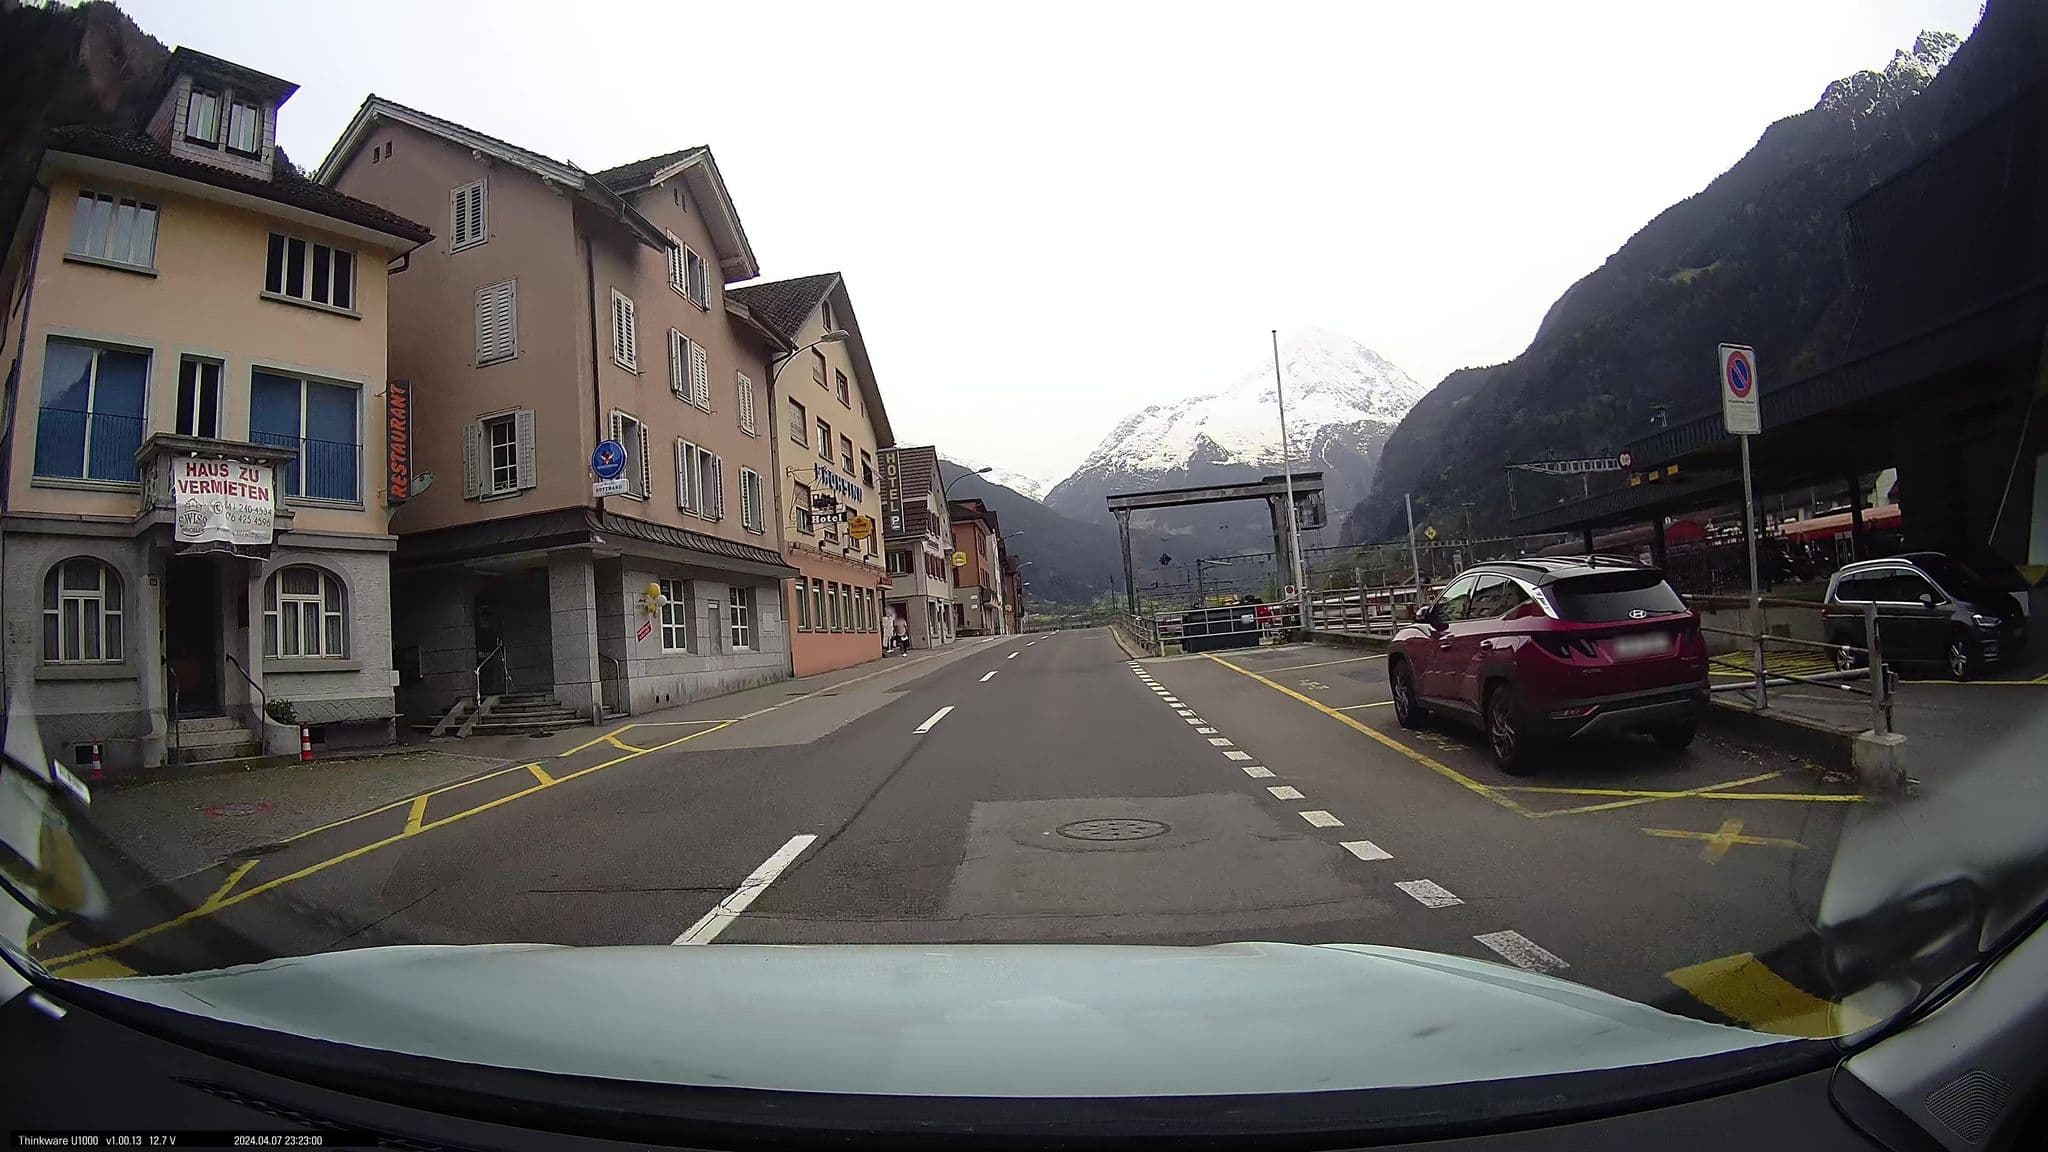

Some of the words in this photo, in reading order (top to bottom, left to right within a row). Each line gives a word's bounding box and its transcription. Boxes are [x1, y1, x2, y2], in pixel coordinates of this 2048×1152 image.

[391, 384, 407, 499] RESTAURANT
[186, 462, 229, 478] HAUS
[239, 466, 260, 483] ZU
[886, 453, 899, 512] HOTEL
[178, 479, 270, 502] VERMIETEN
[239, 503, 253, 514] 240
[811, 514, 842, 524] Hotel
[178, 512, 208, 528] SWISS
